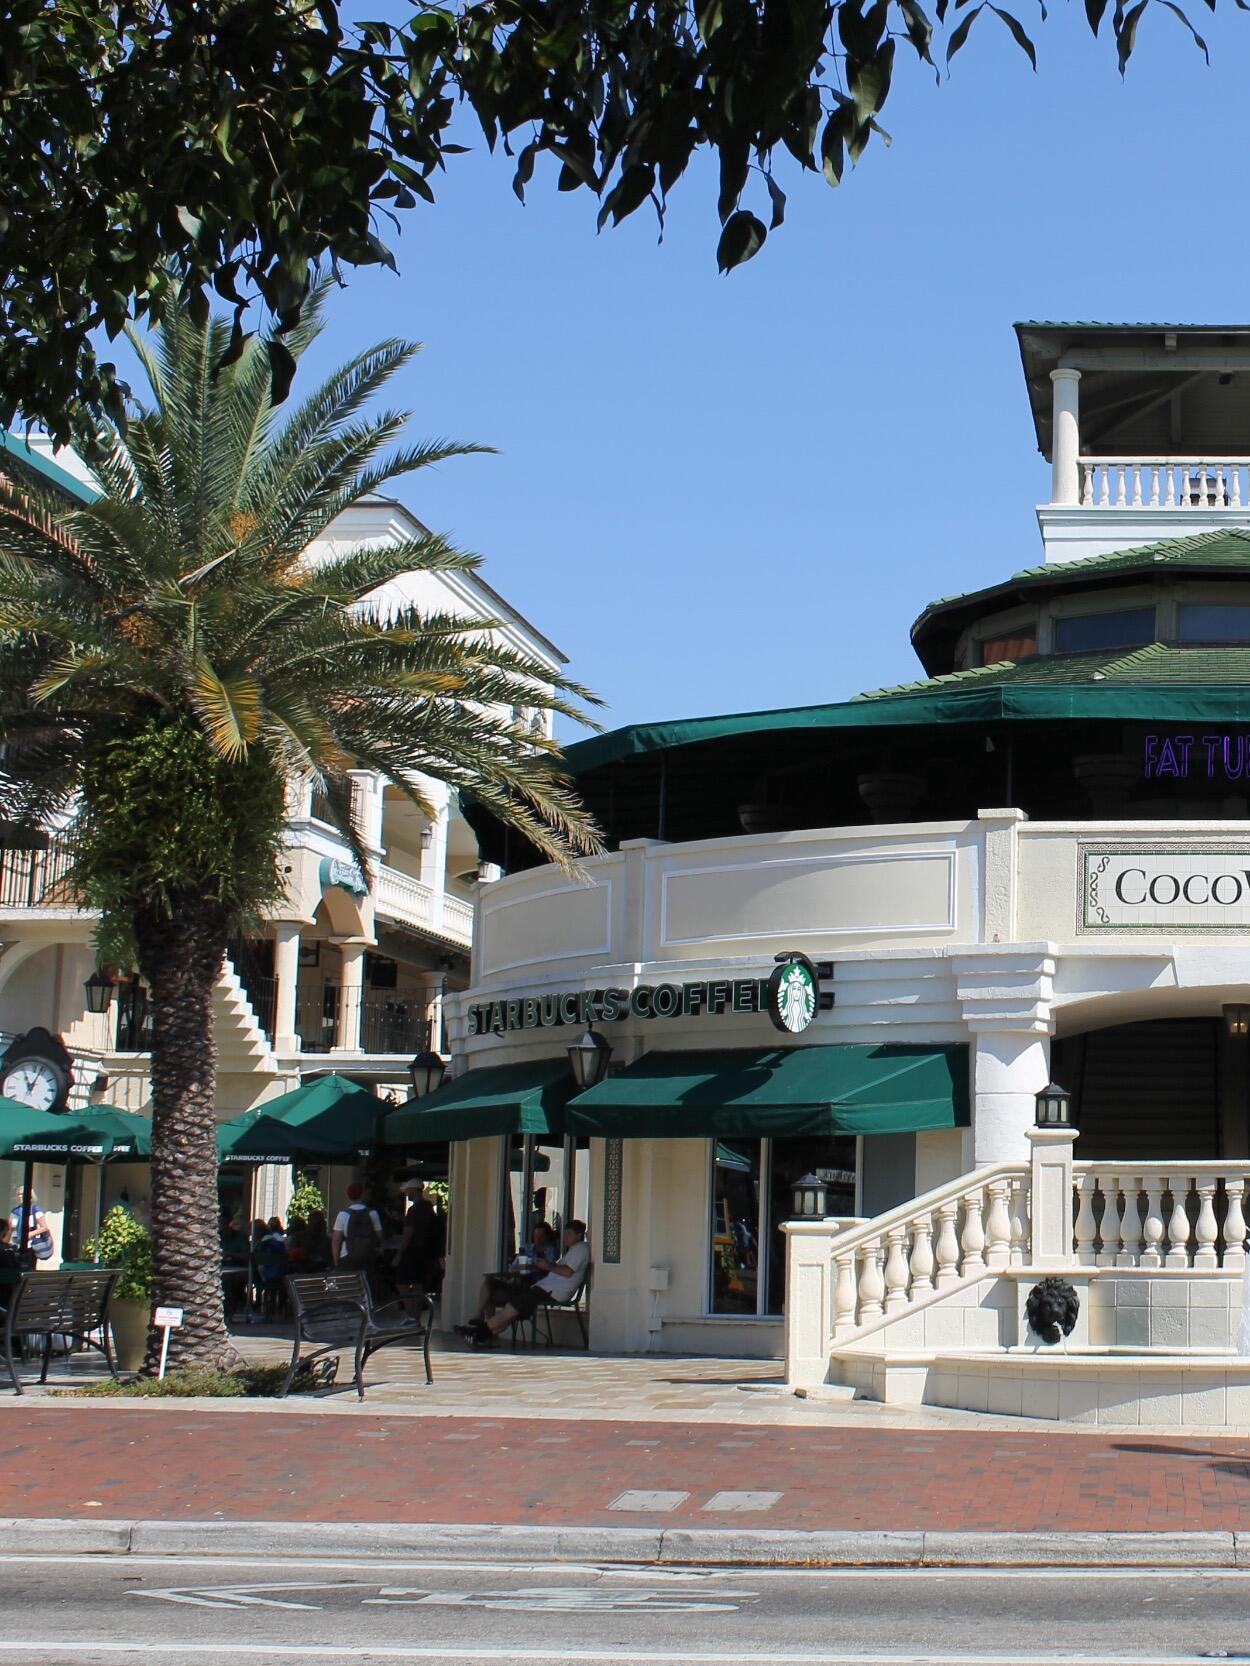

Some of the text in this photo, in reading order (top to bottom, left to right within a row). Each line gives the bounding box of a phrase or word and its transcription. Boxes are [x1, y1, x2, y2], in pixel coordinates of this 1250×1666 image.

[1145, 735, 1195, 778] FAT
[467, 986, 622, 1036] STARBUCKS
[13, 1143, 104, 1153] STARBUCKS COFFEE
